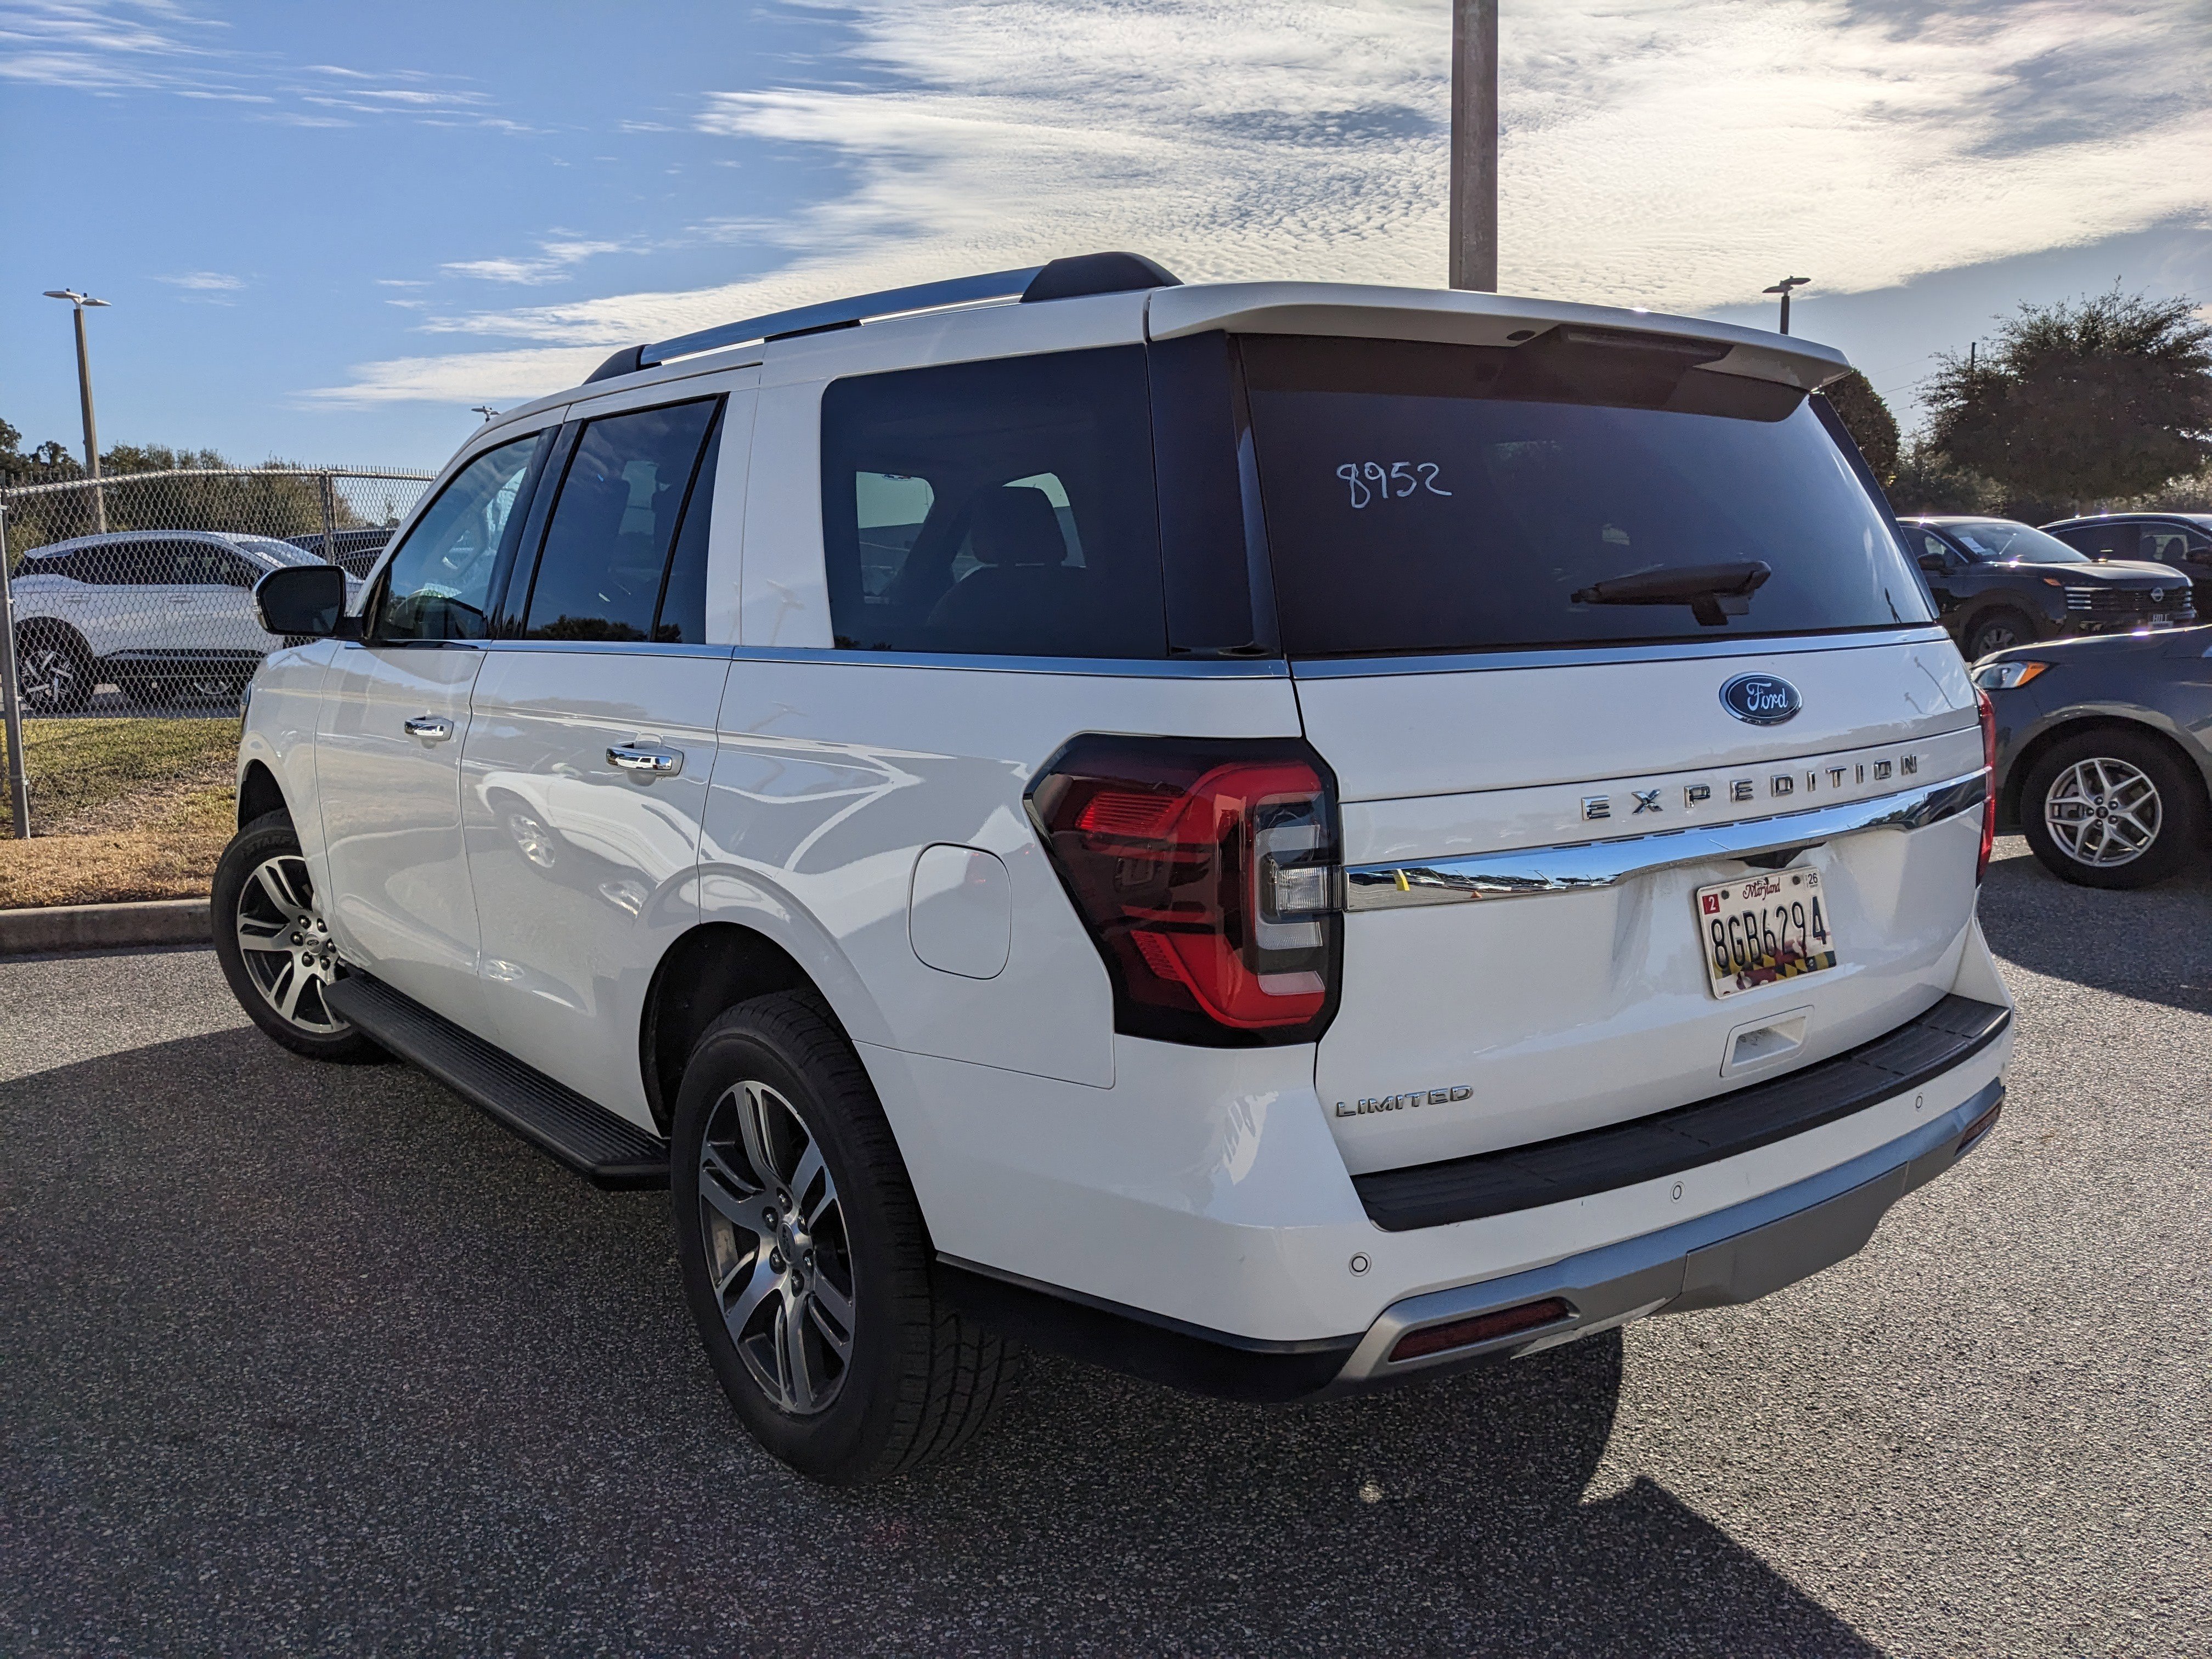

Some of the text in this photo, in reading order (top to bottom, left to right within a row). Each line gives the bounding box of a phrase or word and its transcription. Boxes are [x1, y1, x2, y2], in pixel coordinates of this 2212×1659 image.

[1336, 461, 1453, 509] 8952
[1746, 681, 1789, 712] Ford
[1581, 753, 1918, 821] EXPEDITION
[1742, 877, 1781, 900] Maryland
[1808, 872, 1818, 884] 26
[1708, 896, 1716, 911] 2
[1711, 896, 1827, 969] 8GB6294
[1336, 1085, 1474, 1117] LIMITED
